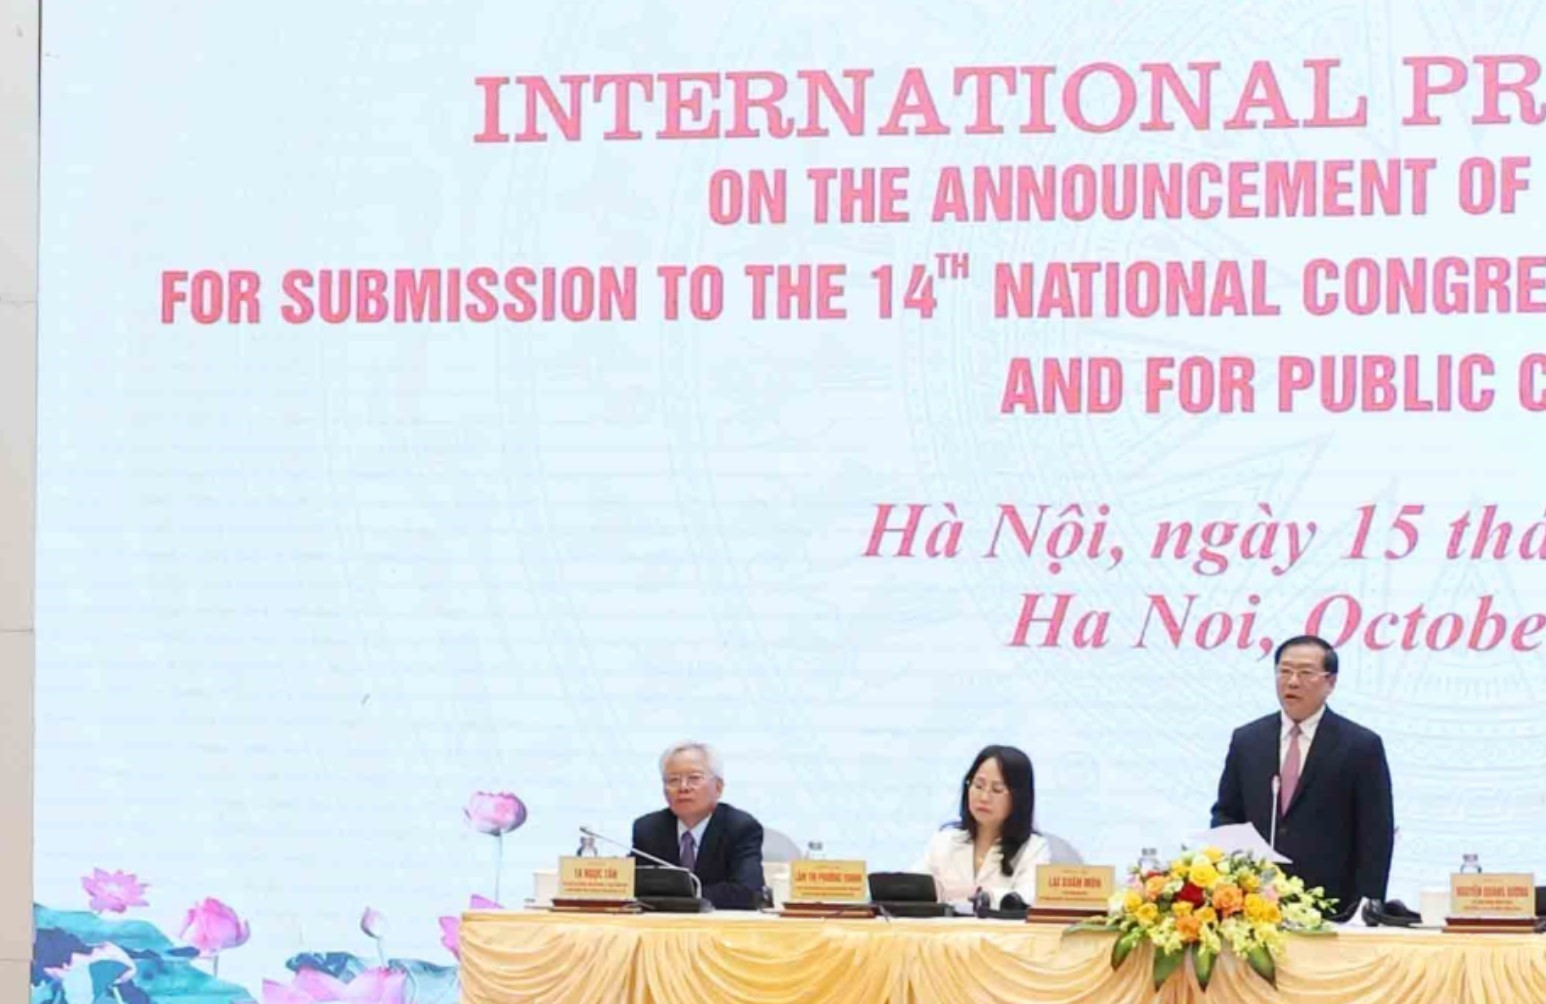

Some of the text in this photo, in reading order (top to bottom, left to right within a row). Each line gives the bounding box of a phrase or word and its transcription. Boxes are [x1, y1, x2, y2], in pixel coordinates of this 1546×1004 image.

[474, 59, 1368, 143] INTERNATIONAL
[708, 168, 787, 226] ON
[807, 166, 908, 224] THE
[931, 157, 1436, 222] ANNOUNCEMENT
[1458, 155, 1530, 215] OF
[160, 268, 260, 325] FOR
[280, 265, 636, 325] SUBMISSION
[658, 263, 723, 321] TO
[745, 263, 845, 321] THE
[873, 252, 969, 318] 14TH
[994, 259, 1278, 318] NATIONAL
[1001, 356, 1124, 414] AND
[1145, 354, 1255, 414] FOR
[1277, 353, 1494, 413] PUBLIC
[864, 503, 963, 558] Hà
[982, 503, 1124, 575] Nội,
[1151, 503, 1316, 576] ngày
[1341, 503, 1425, 560] 15
[1009, 592, 1111, 649] Ha
[1134, 594, 1274, 661] Noi,
